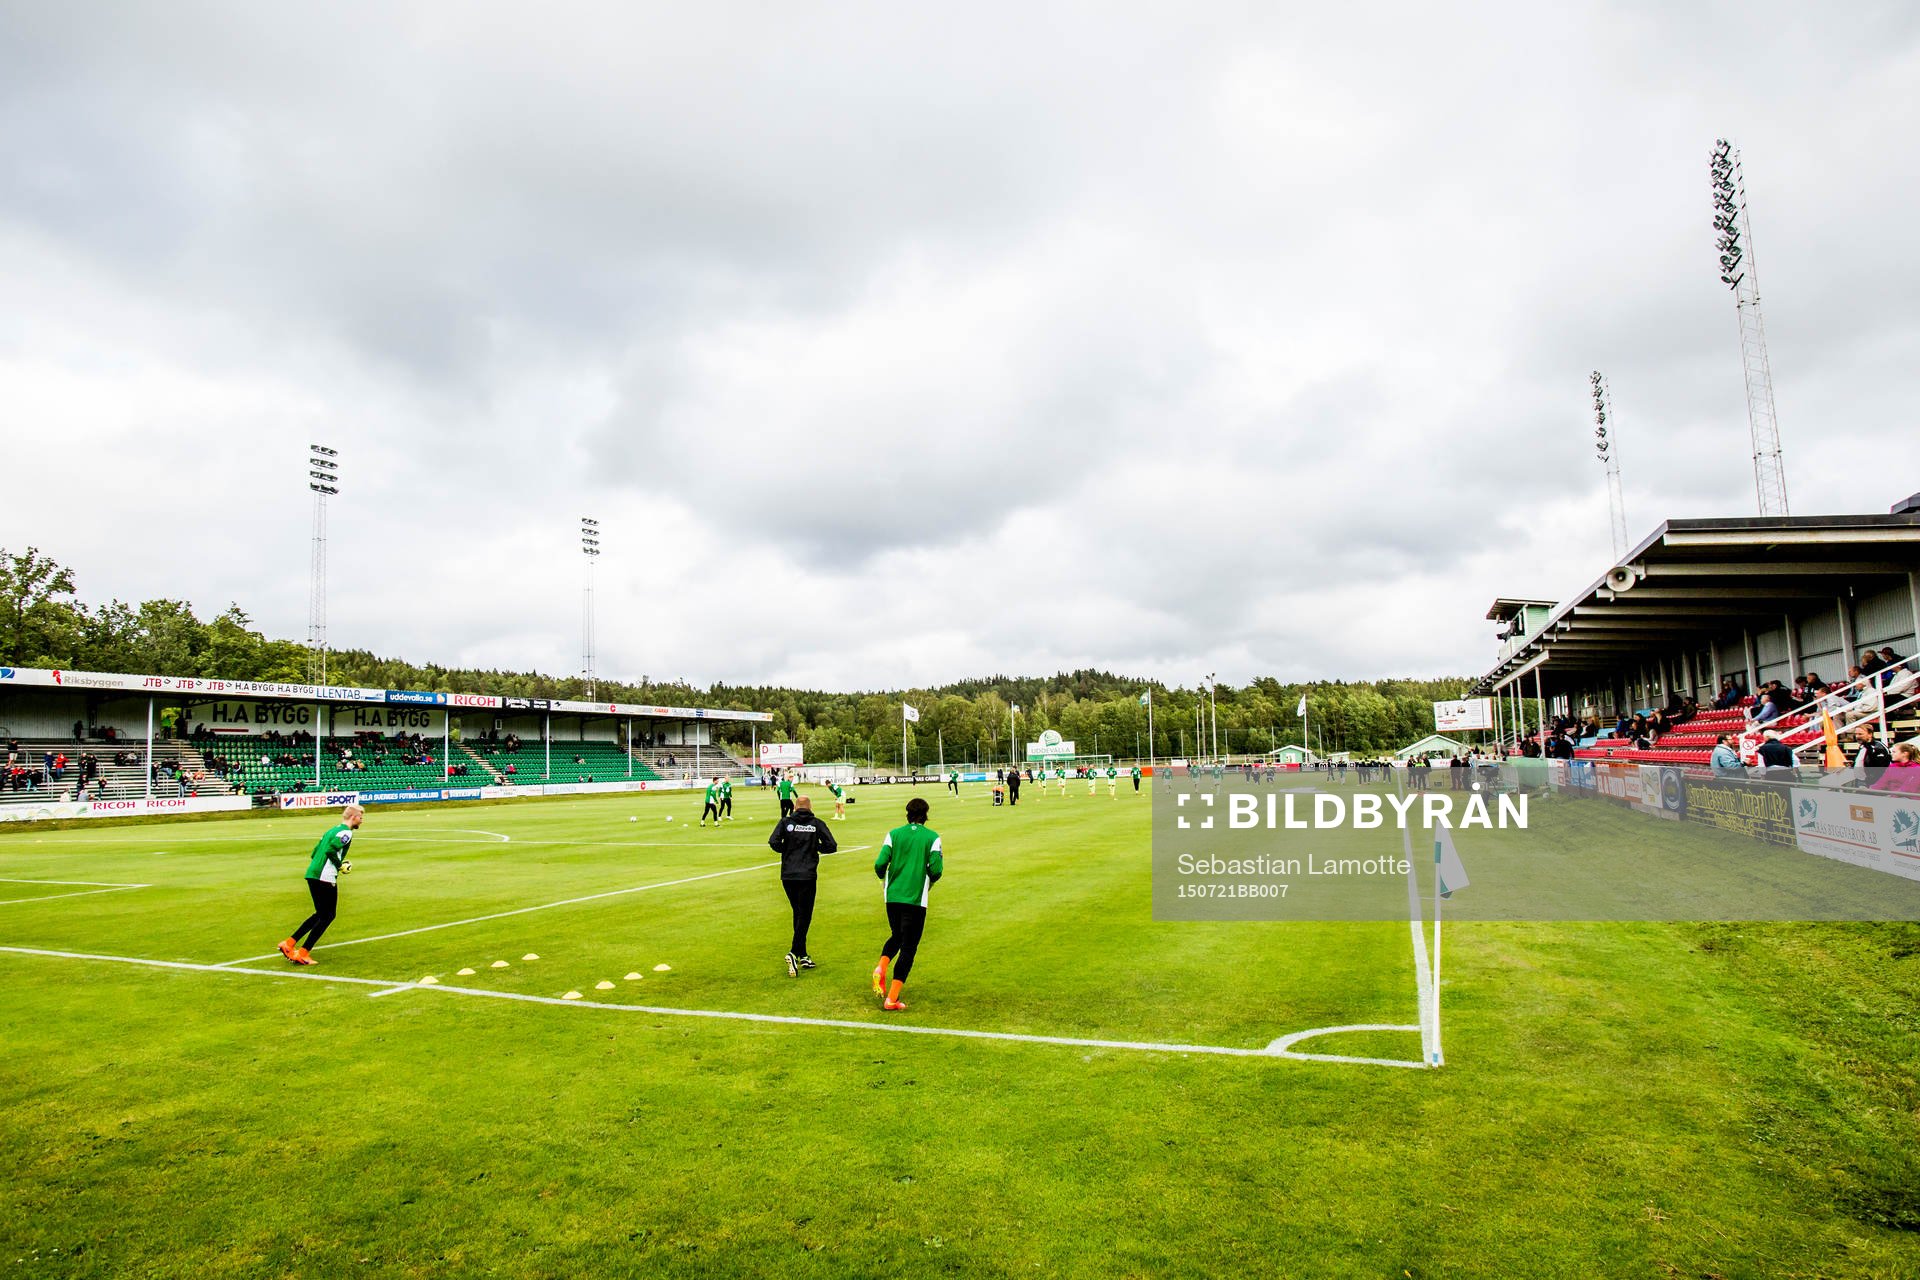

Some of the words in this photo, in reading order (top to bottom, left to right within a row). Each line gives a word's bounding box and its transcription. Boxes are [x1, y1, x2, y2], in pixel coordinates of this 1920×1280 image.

[64, 675, 124, 687] Riksbyggen
[143, 677, 162, 688] JTB
[176, 680, 194, 689] JTB
[207, 681, 224, 690] JTB
[251, 682, 275, 692] BYGG
[292, 685, 314, 694] BYGG
[316, 689, 361, 700] LLENTAB
[389, 693, 433, 703] uddevalla.se
[454, 695, 496, 707] RICOH
[212, 703, 249, 723] H.A
[255, 704, 310, 724] BYGG
[354, 709, 383, 726] H.A
[386, 710, 430, 728] BYGG
[93, 801, 136, 810] RICOH
[146, 799, 186, 808] RICOH
[296, 795, 356, 807] INTERSPORT
[1868, 831, 1878, 845] AB
